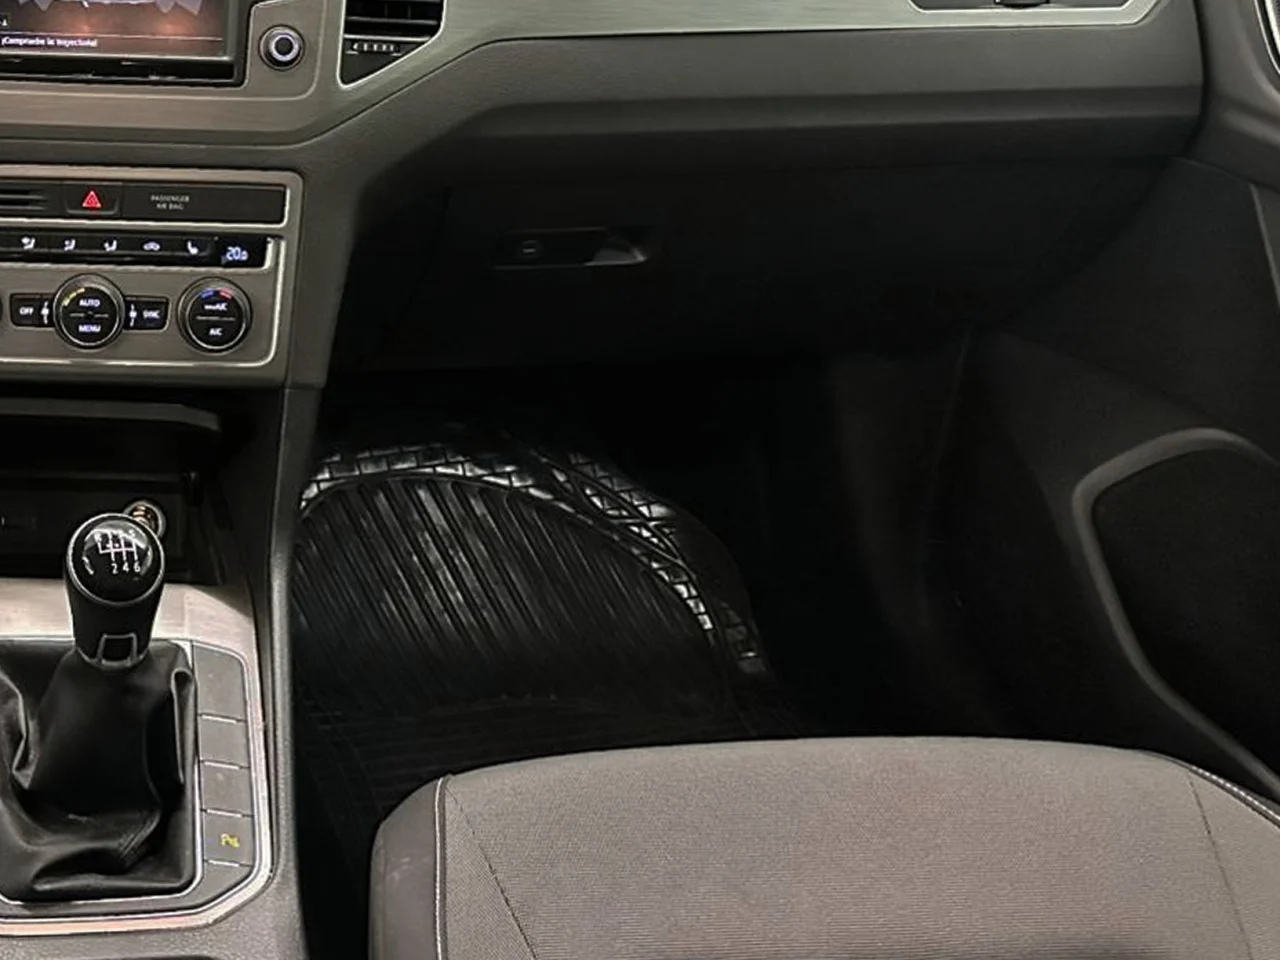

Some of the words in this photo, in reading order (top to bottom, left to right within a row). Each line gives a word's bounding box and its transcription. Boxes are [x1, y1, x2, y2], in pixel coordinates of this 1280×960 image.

[150, 194, 190, 203] PASSENGER
[79, 298, 101, 307] AUTO
[19, 306, 34, 315] OFF
[78, 324, 101, 333] MENU
[111, 562, 118, 575] 2
[122, 561, 130, 573] 4
[133, 561, 141, 573] 6
